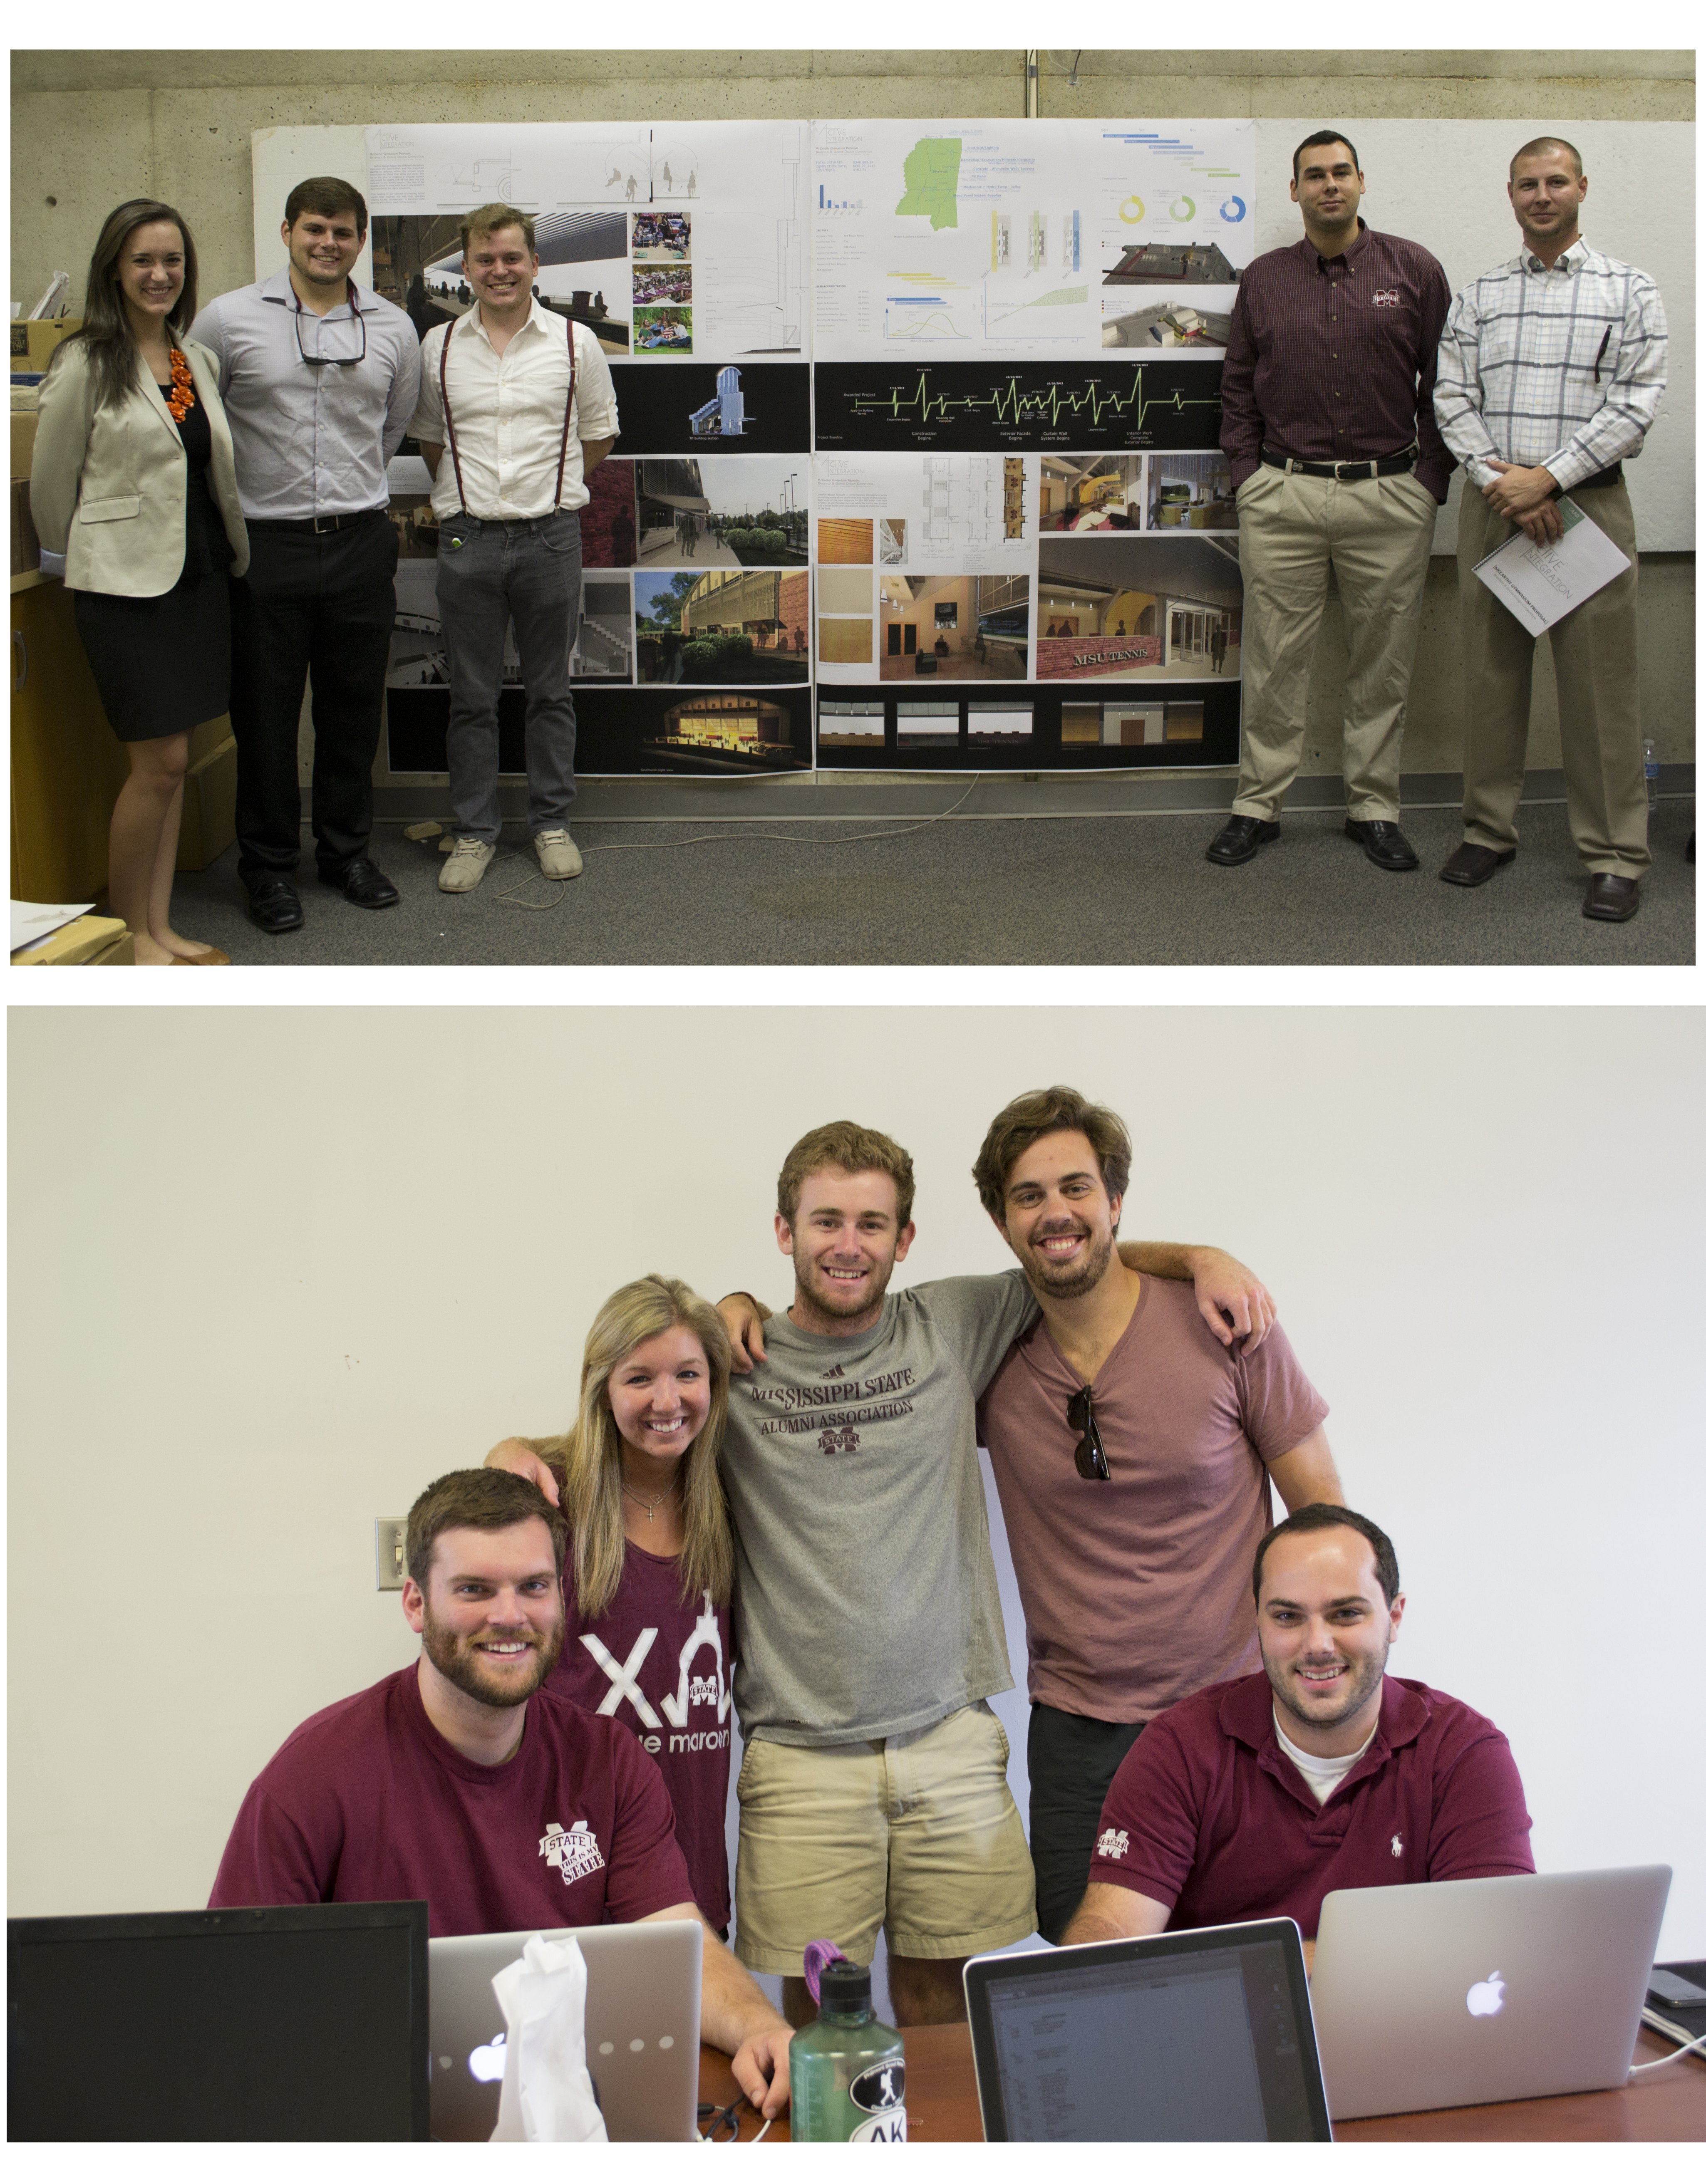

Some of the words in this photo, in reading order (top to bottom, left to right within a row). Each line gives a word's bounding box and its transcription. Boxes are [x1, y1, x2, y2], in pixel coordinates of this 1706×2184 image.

[1510, 583, 1531, 605] GYMNASIUM
[1074, 652, 1106, 666] MSU
[1107, 649, 1148, 661] TENNIS
[752, 1382, 860, 1410] MISSISSIPPI
[864, 1368, 916, 1397] STATE
[761, 1416, 815, 1435] ALUMNI
[819, 1400, 913, 1428] ASSOCIATION
[825, 1435, 853, 1444] STATE
[694, 1684, 715, 1694] STATE
[549, 1835, 586, 1850] STATE
[1103, 1838, 1124, 1849] STATE
[560, 1856, 577, 1869] THIS
[578, 1851, 585, 1860] IS
[587, 1844, 598, 1855] MY
[563, 1852, 604, 1884] STATE
[870, 2115, 904, 2143] AK
